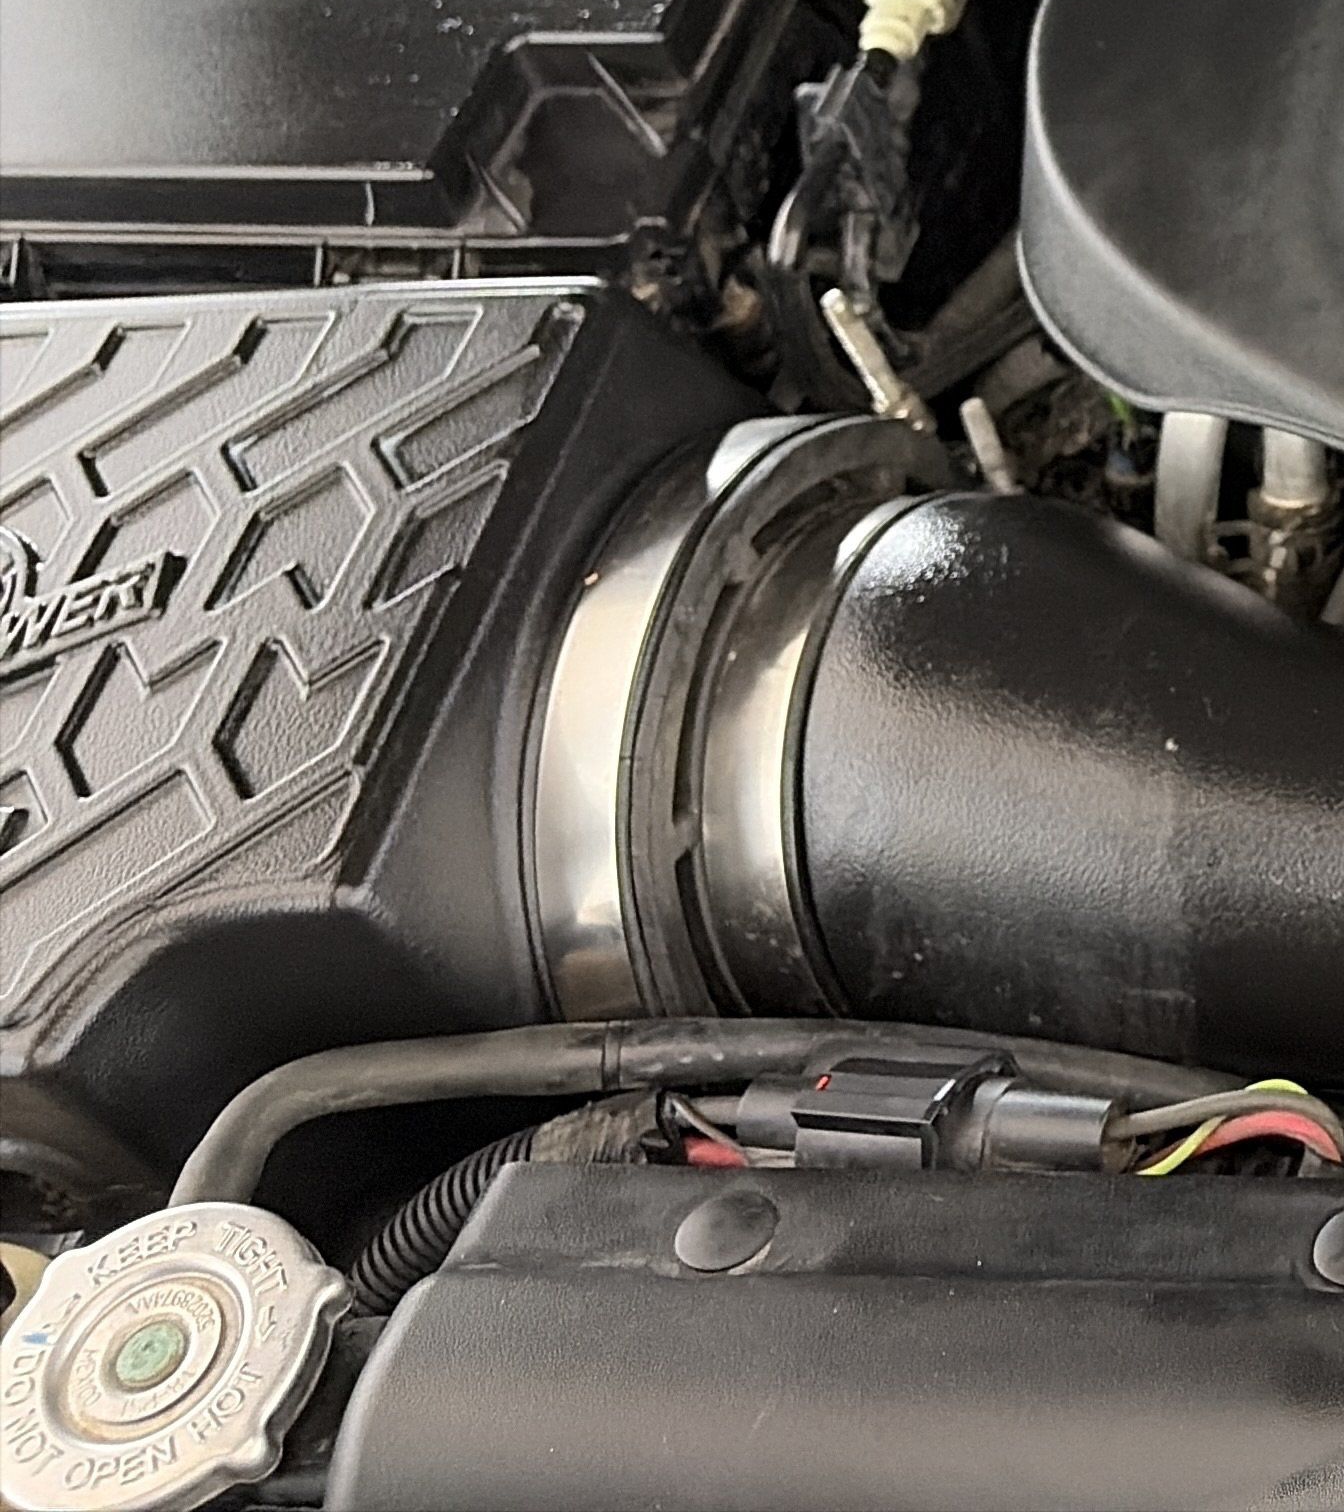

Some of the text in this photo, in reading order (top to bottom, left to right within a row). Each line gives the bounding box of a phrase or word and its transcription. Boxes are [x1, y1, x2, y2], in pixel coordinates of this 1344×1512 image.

[87, 1219, 290, 1296] KEEP TIGHT
[3, 1410, 66, 1477] NOT
[64, 1437, 179, 1492] OPEN
[186, 1360, 263, 1444] HOT
